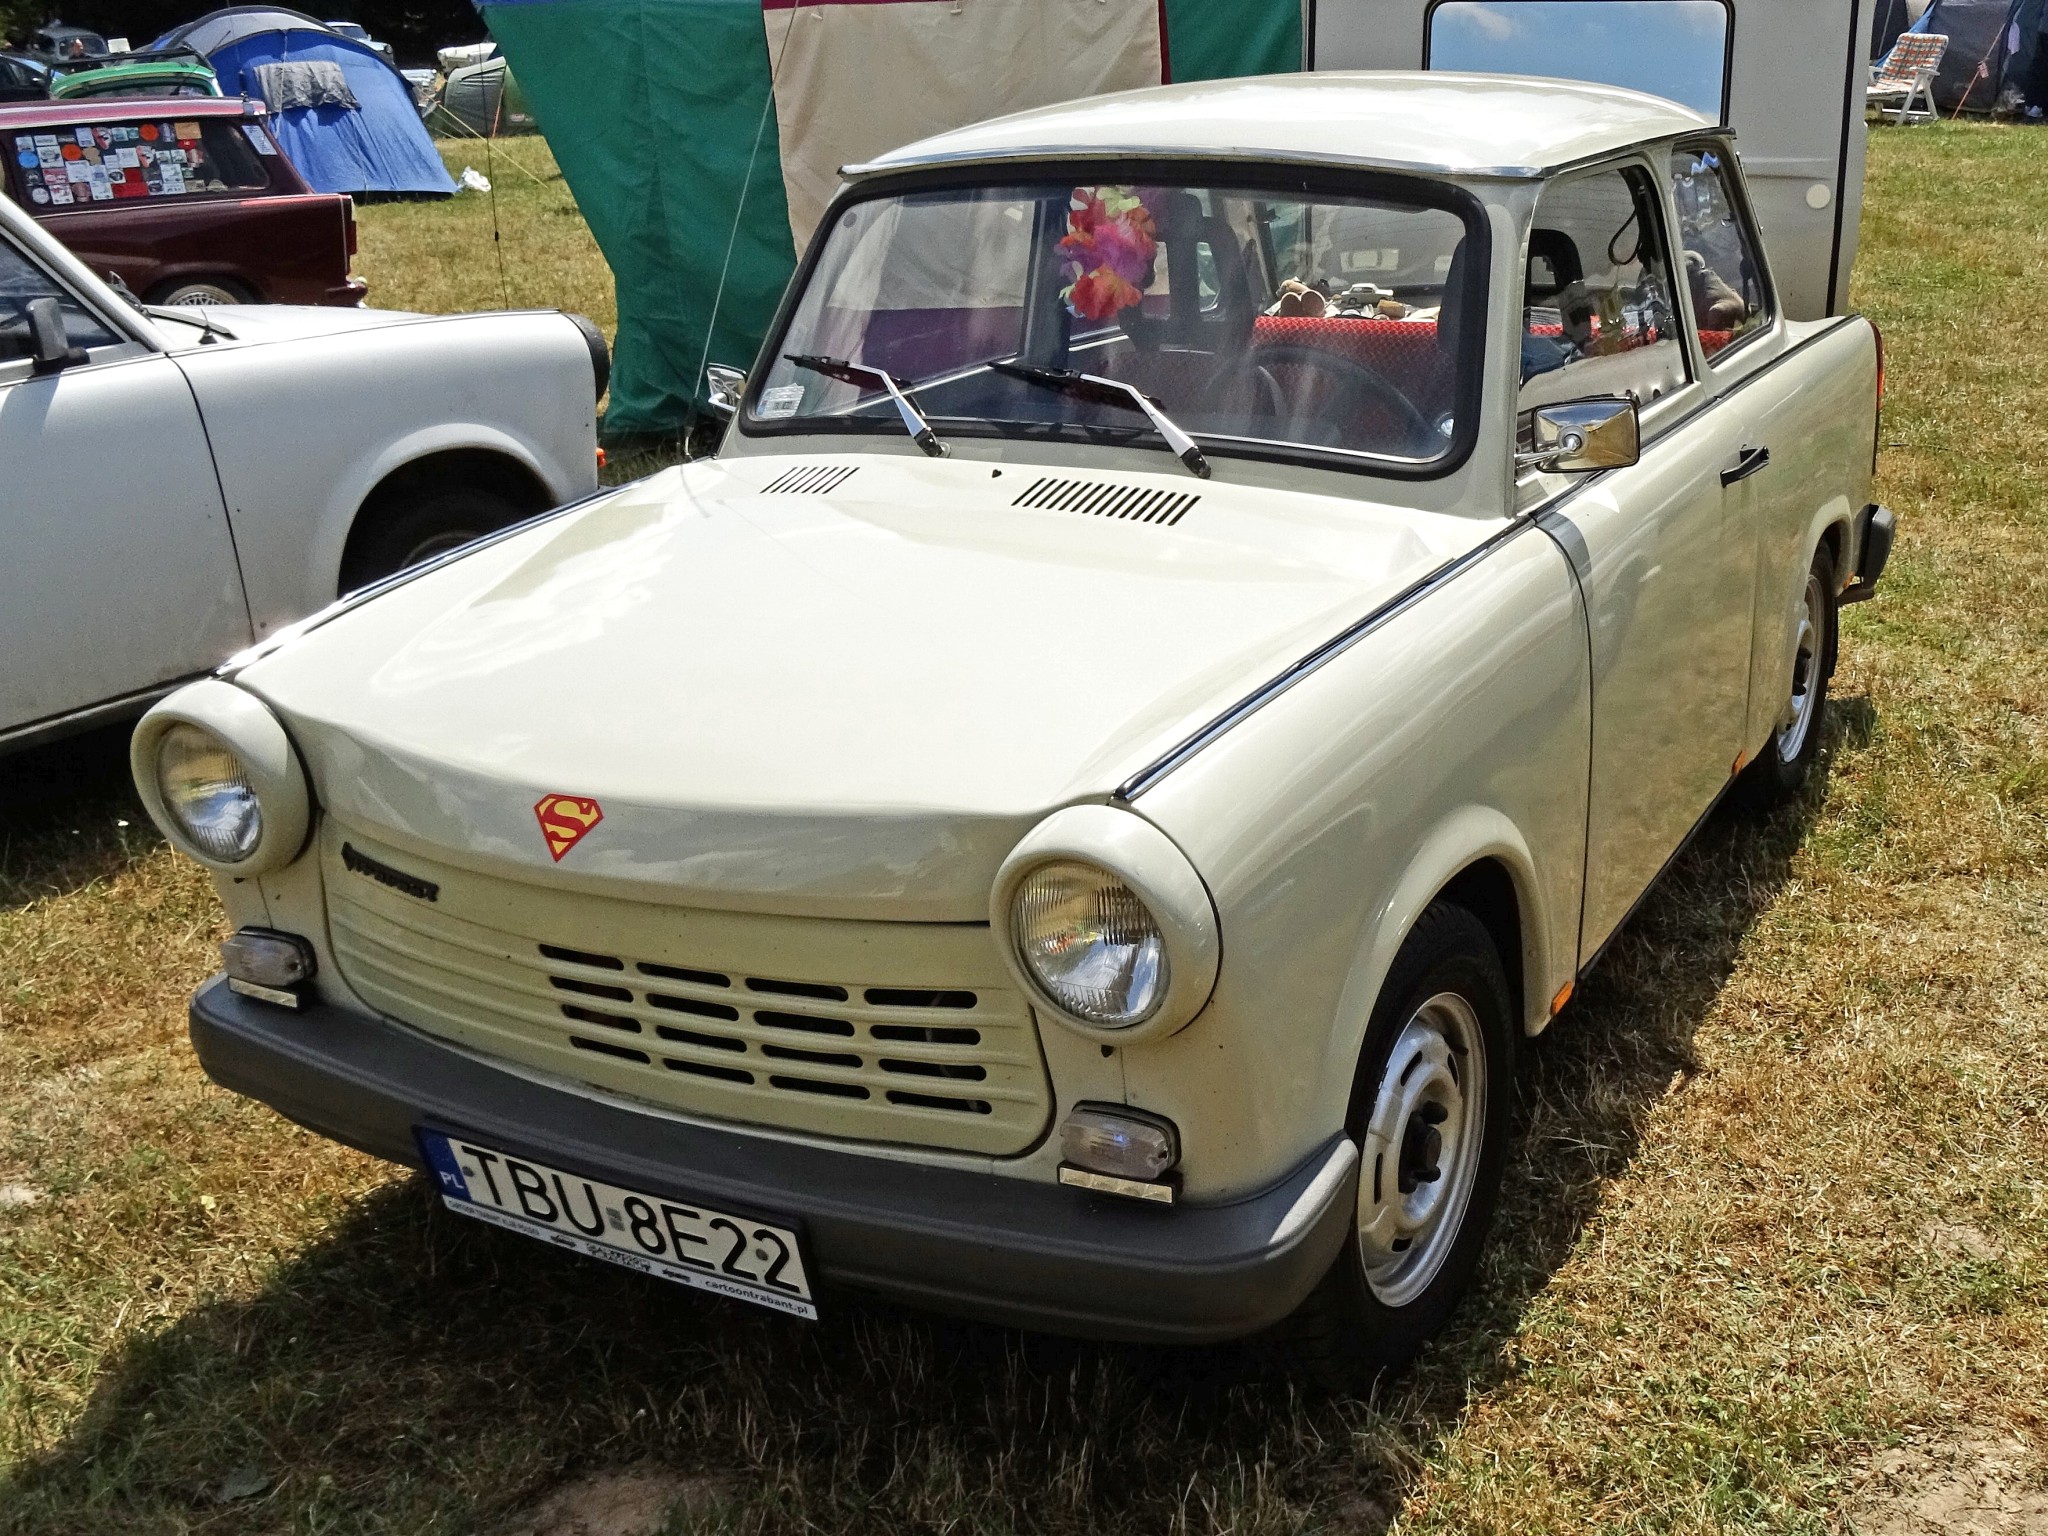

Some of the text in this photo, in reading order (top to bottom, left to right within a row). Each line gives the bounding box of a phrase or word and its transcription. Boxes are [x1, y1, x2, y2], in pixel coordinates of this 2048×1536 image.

[440, 1170, 465, 1189] PL
[461, 1145, 801, 1293] TBU 8E22
[705, 1280, 808, 1314] cartoontrabant.pl
